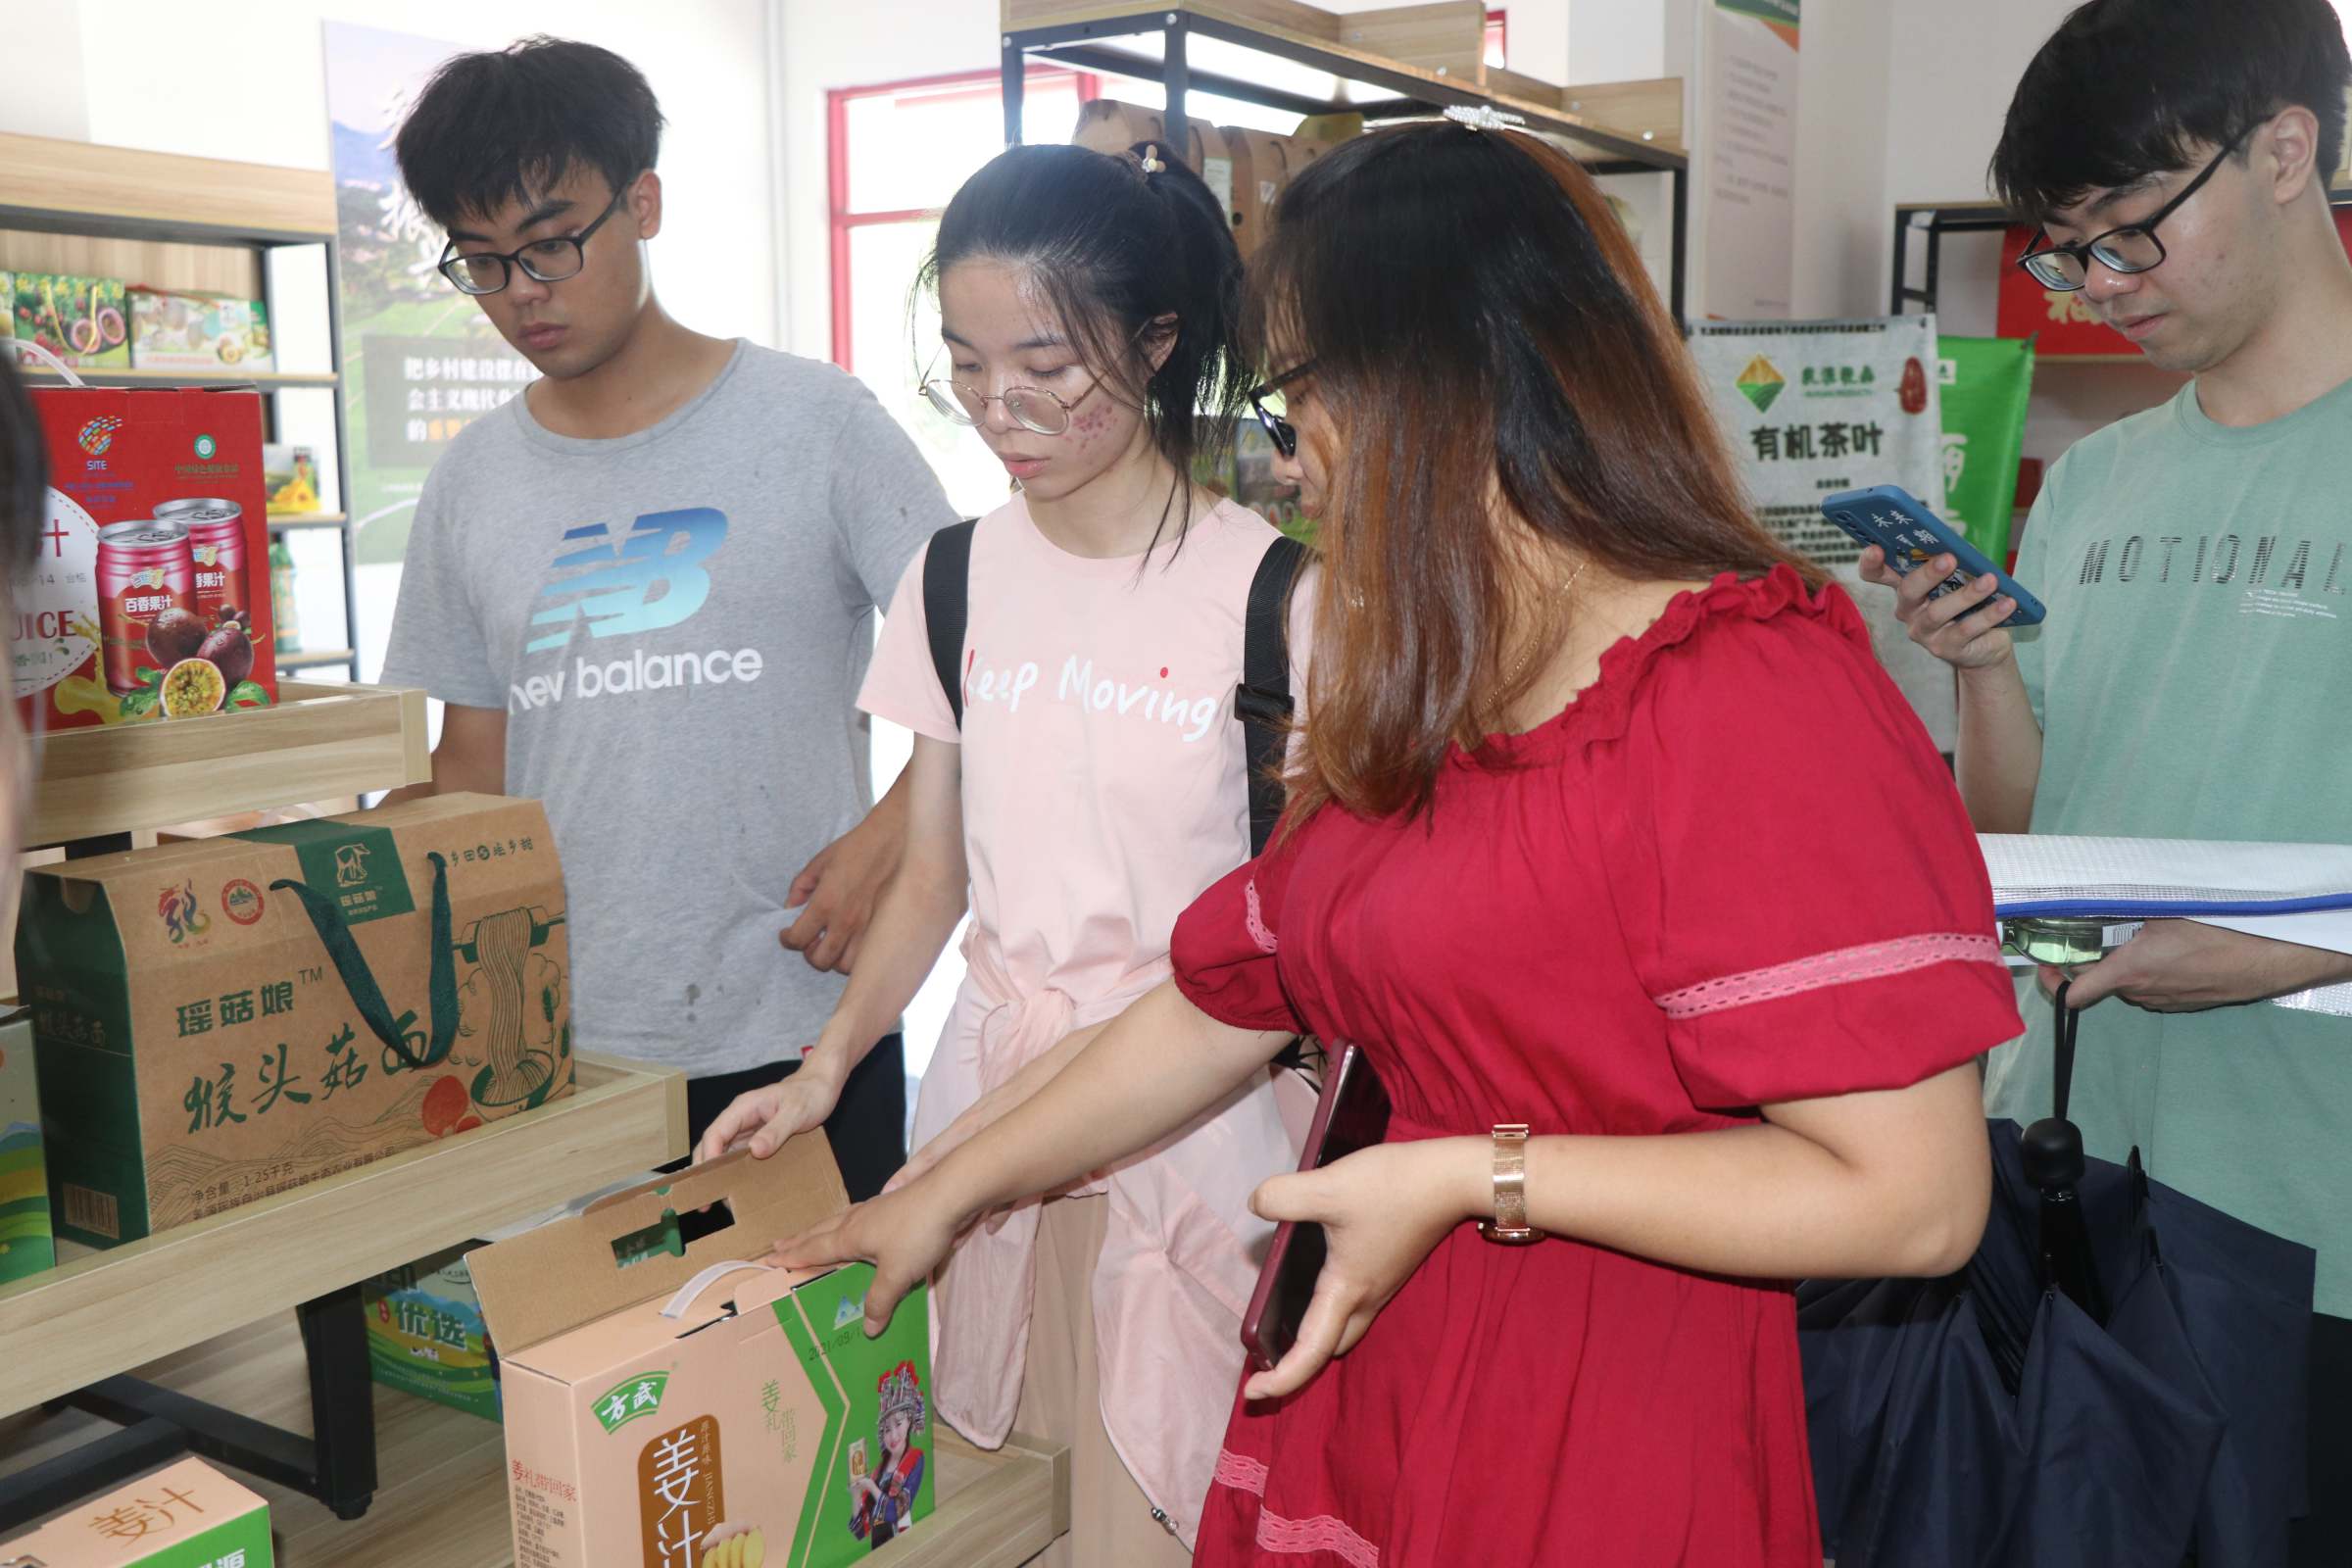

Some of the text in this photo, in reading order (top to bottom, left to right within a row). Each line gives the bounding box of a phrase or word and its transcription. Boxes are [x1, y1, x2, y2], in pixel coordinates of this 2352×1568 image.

[1751, 420, 1885, 462] 有机茶叶
[86, 461, 108, 470] SITE
[195, 570, 225, 590] 香果汁
[124, 595, 173, 613] 百香果汁
[576, 648, 763, 699] balance
[1057, 654, 1217, 742] Moving
[176, 966, 322, 1038] 瑶菇娘 TM
[183, 1009, 429, 1135] 猴头菇面
